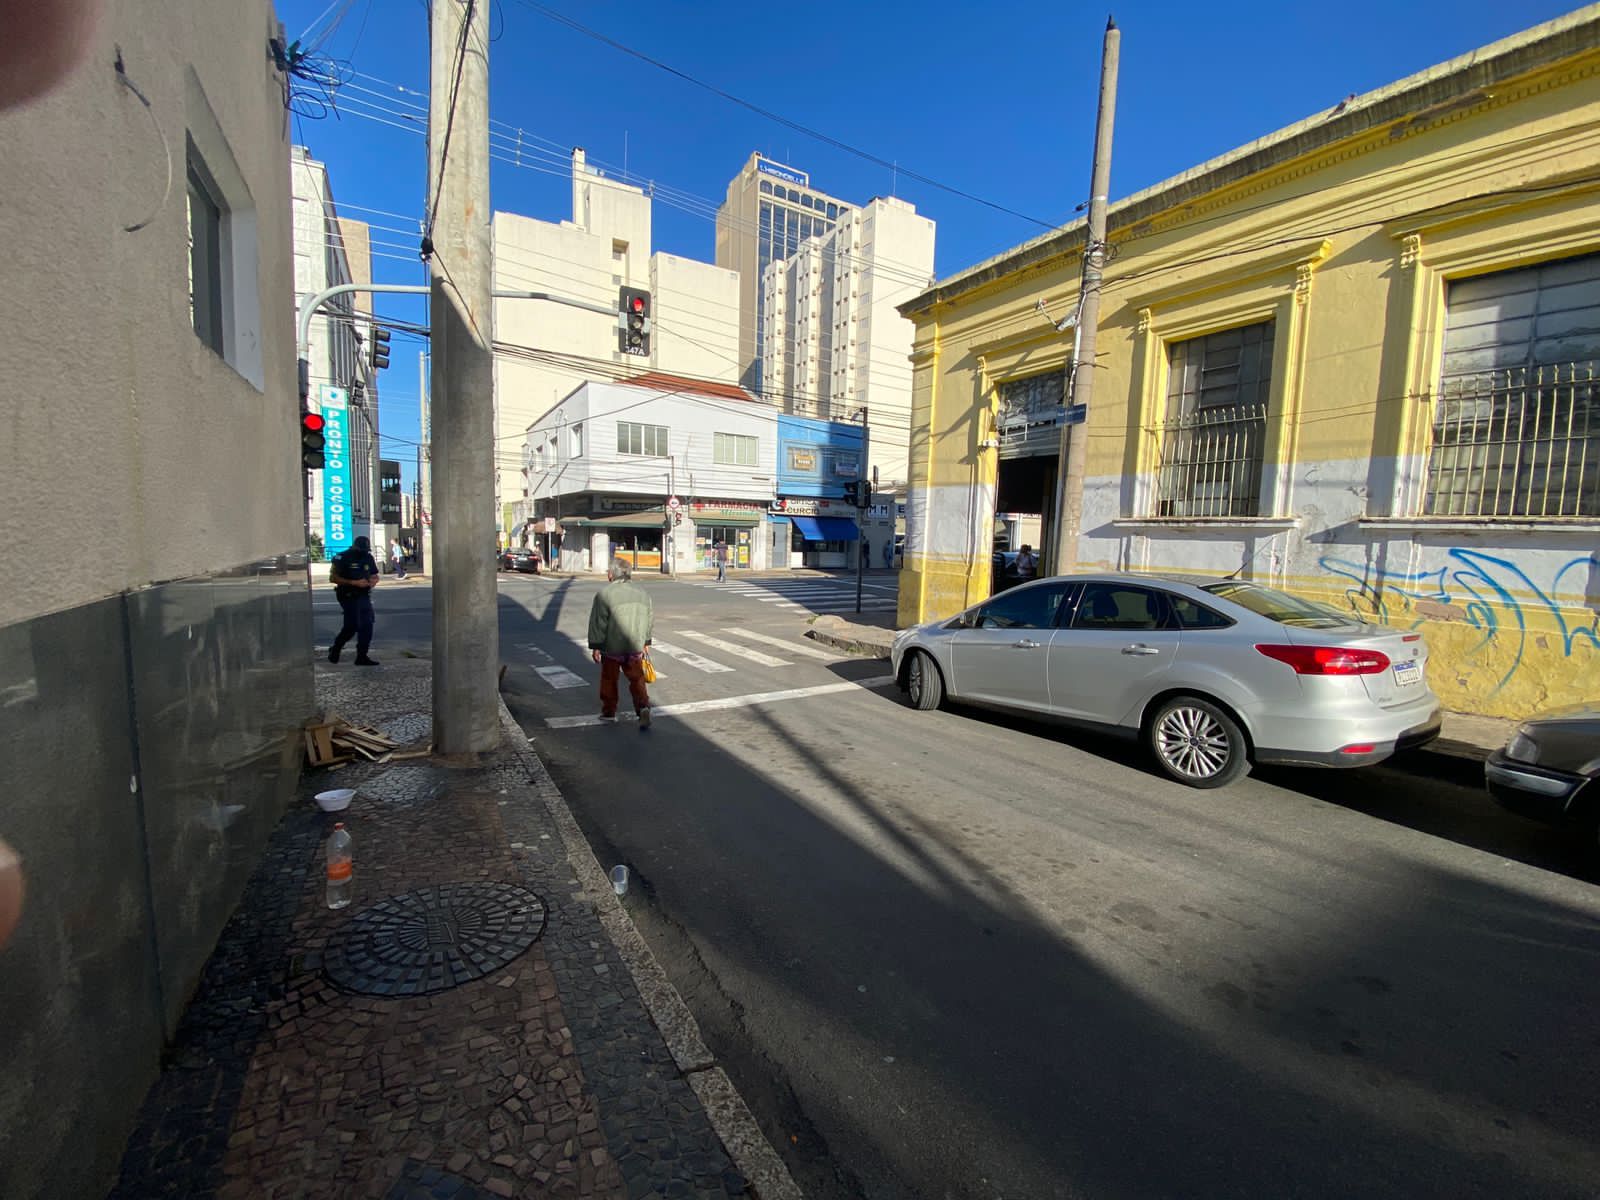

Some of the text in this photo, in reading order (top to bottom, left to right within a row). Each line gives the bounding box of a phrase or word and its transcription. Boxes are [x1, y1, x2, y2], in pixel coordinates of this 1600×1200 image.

[328, 411, 343, 468] PRONTO
[331, 476, 345, 540] SOCORRO
[786, 507, 820, 515] CURCIO
